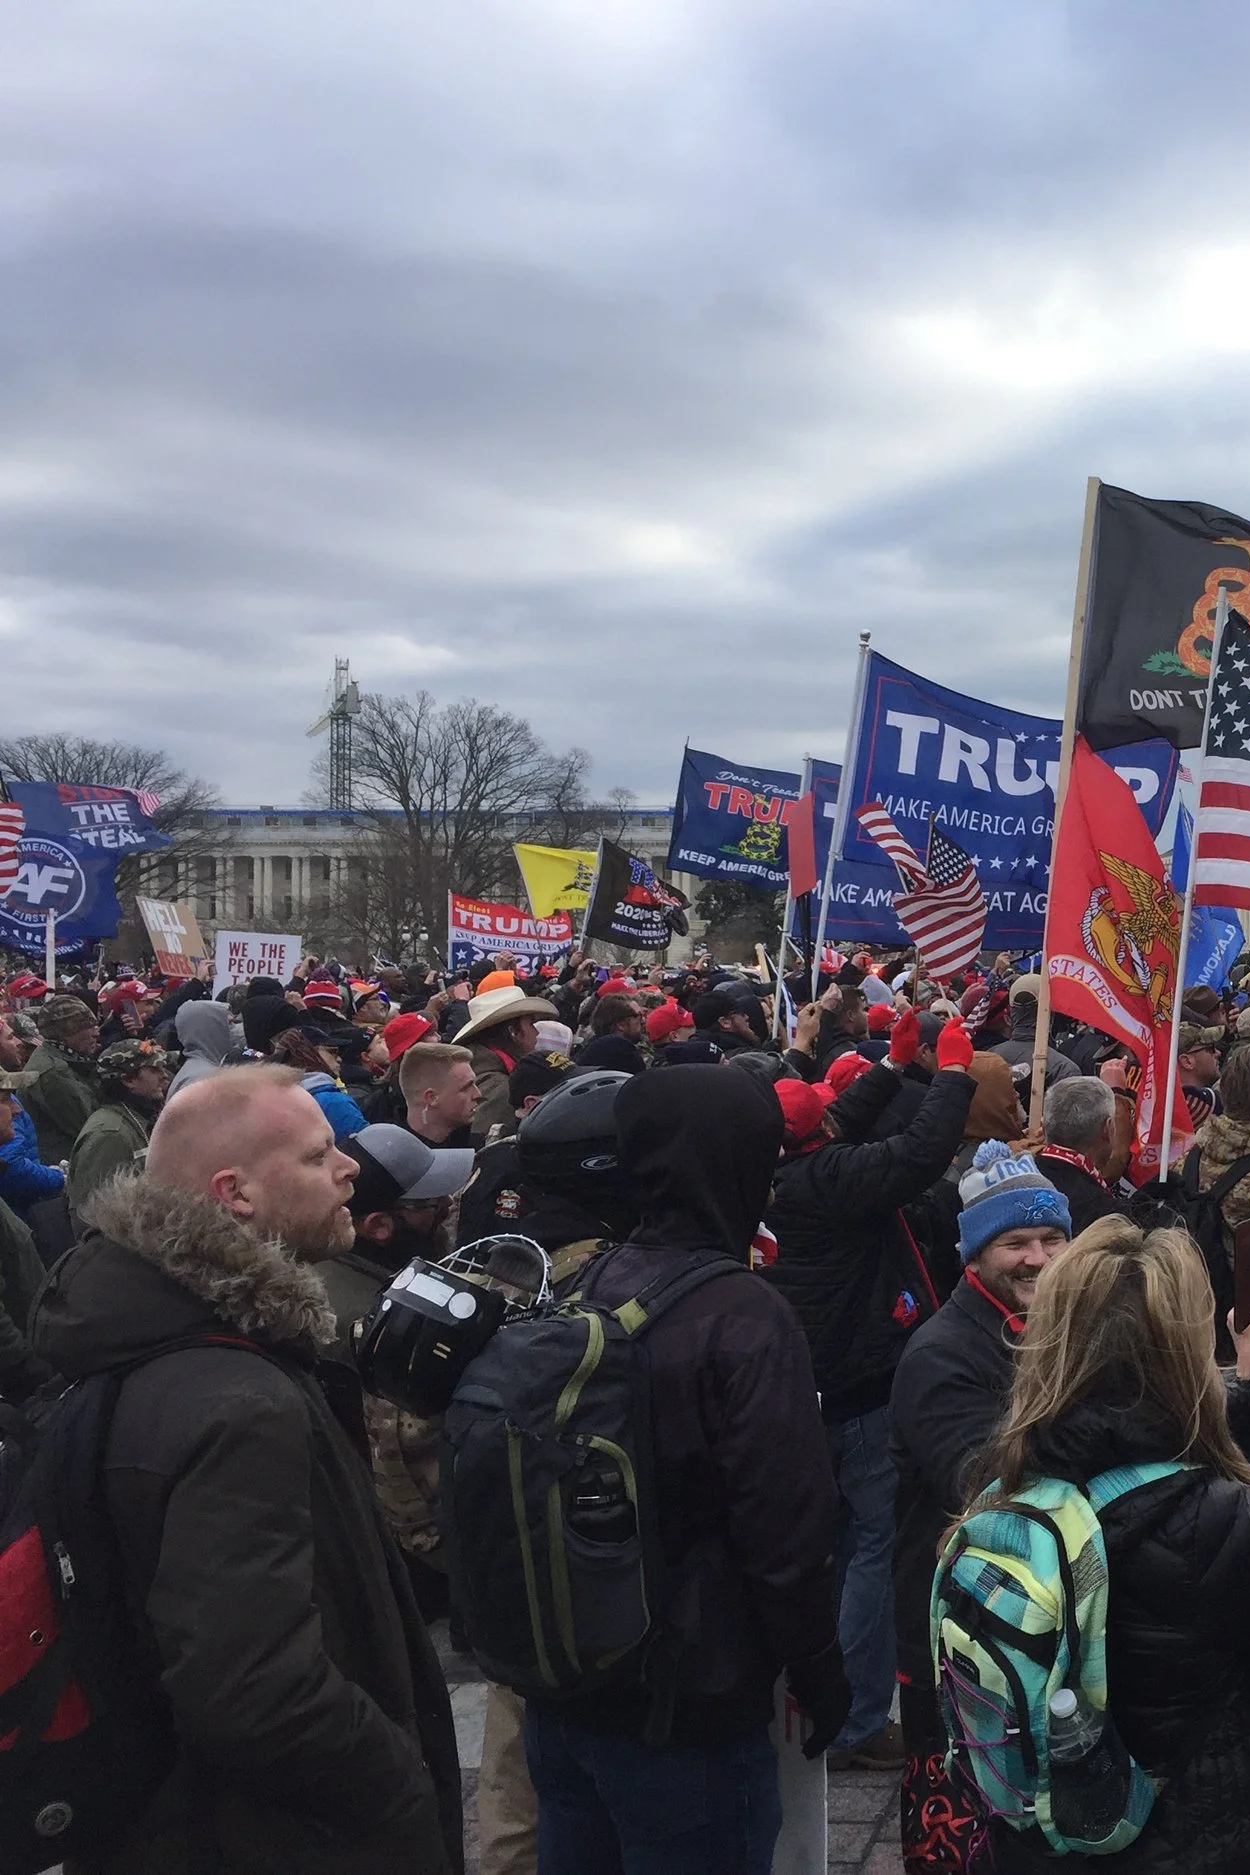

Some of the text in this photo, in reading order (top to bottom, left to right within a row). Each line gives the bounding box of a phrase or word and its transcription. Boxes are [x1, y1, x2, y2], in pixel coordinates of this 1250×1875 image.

[1129, 688, 1185, 711] DONT
[715, 770, 761, 788] Don't
[70, 802, 131, 825] THE
[934, 803, 1027, 837] AMERICA
[678, 848, 717, 867] KEEP
[1, 862, 75, 905] AF
[455, 907, 569, 938] TRUMP
[228, 941, 286, 959] WE THE
[479, 936, 533, 951] AMERICA
[228, 957, 285, 975] PEOPLE
[1050, 958, 1118, 1010] STATES
